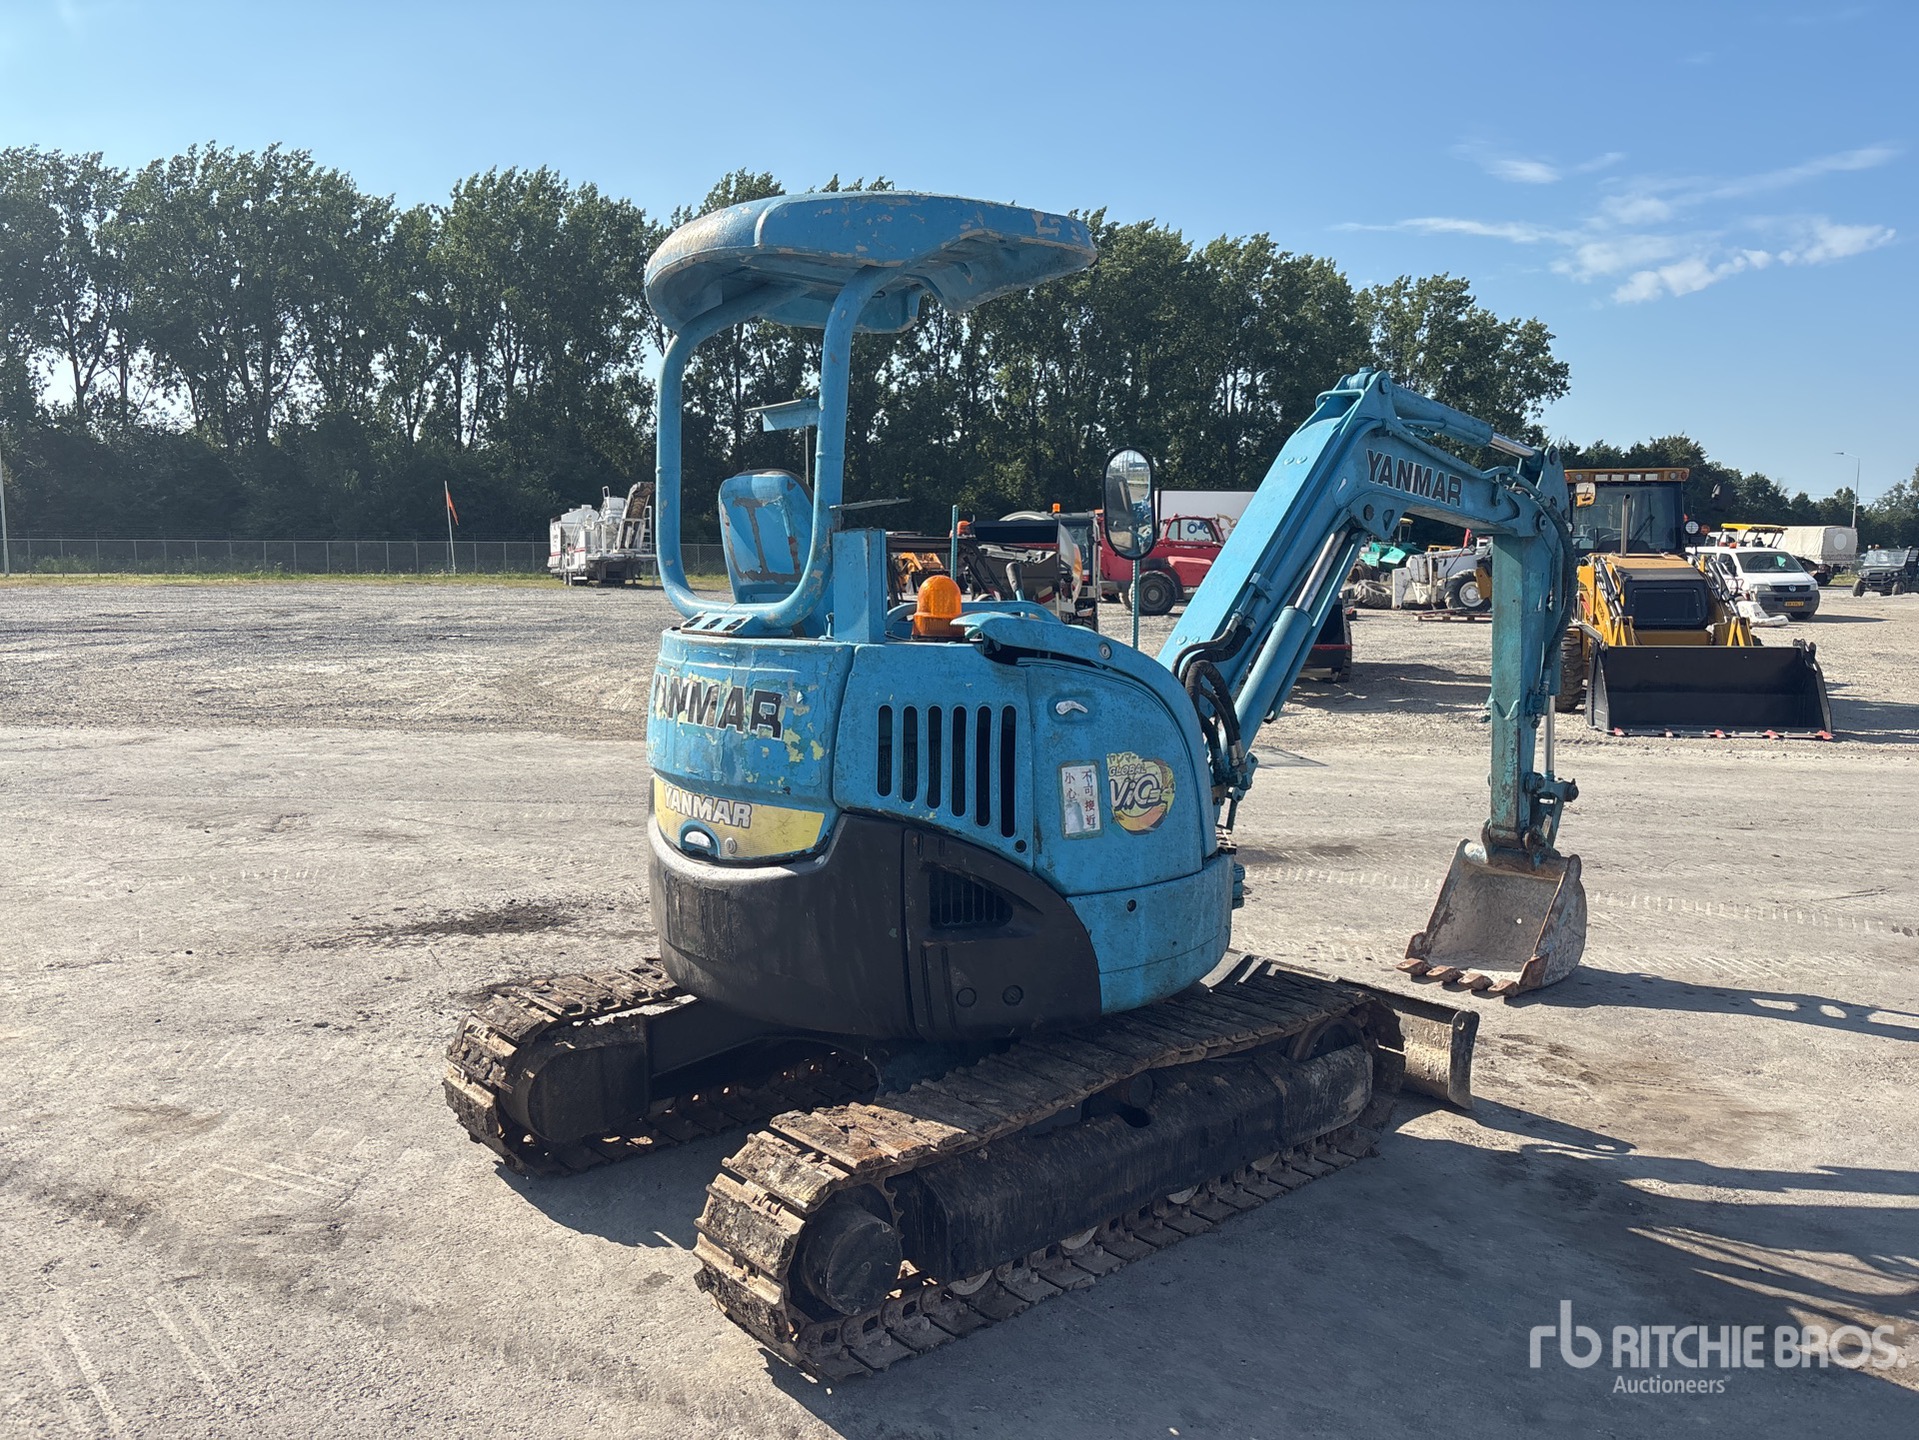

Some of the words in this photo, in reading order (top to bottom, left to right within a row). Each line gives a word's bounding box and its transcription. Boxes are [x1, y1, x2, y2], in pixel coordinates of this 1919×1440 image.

[1366, 450, 1463, 508] YANMAR
[1109, 764, 1147, 777] GLOBAL
[663, 785, 752, 829] YANMAR
